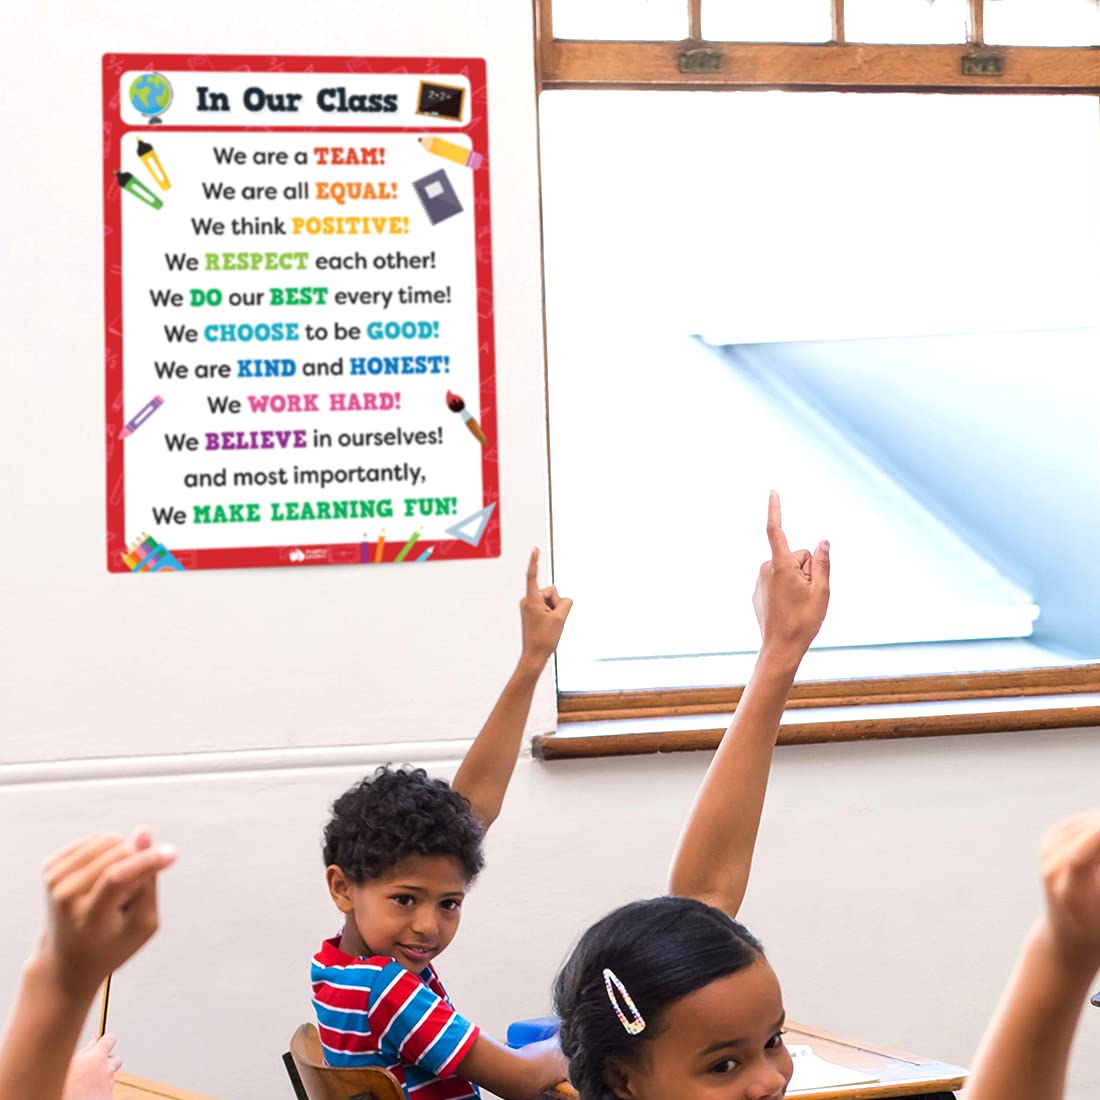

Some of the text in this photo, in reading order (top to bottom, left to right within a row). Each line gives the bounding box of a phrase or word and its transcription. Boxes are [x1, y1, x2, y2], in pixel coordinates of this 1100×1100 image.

[196, 86, 398, 113] In Our Class
[213, 147, 385, 165] We are a TEAM!
[202, 182, 397, 205] We are all EQUAL!
[191, 216, 409, 235] We think POSITIVE!
[165, 251, 436, 271] We RESPECT each other!
[149, 286, 451, 309] We DO our BEST every time!
[164, 321, 439, 343] We CHOOSE to be GOOD!
[154, 355, 450, 379] We are KIND and HONEST!
[207, 392, 400, 414] We WORK HARD!
[164, 427, 443, 451] We BELIEVE in ourselves!
[184, 462, 426, 488] and most importantly,
[152, 497, 457, 525] We MAKE LEARNING FUN!
